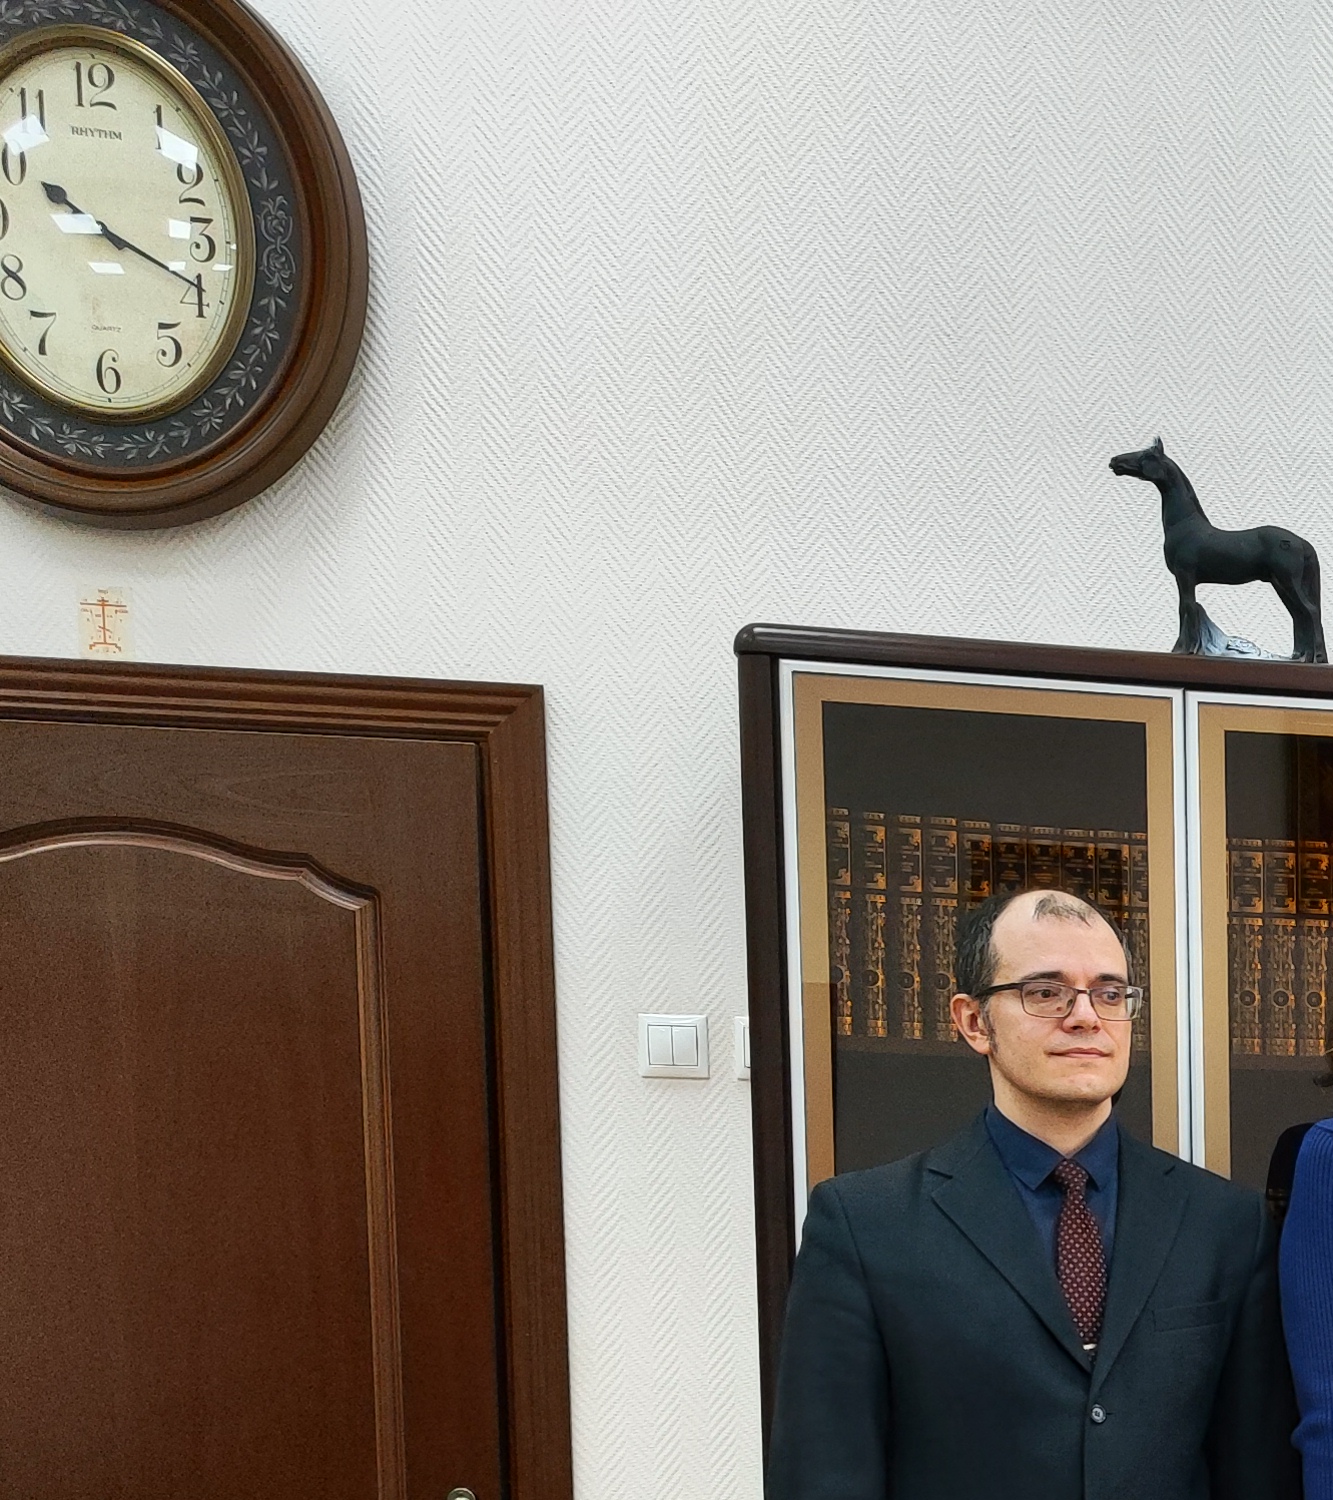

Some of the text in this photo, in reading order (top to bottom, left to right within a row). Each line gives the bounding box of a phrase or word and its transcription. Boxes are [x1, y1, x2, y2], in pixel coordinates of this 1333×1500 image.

[73, 61, 117, 110] 12
[17, 87, 50, 138] 11
[70, 126, 122, 141] RHYTHM
[153, 104, 163, 150] 1
[177, 160, 206, 207] 2
[190, 216, 216, 262] 3
[0, 254, 27, 300] 8
[180, 273, 210, 318] 4
[29, 310, 57, 356] 7
[91, 324, 122, 333] QUARTZ
[156, 322, 182, 368] 5
[96, 348, 122, 395] 6
